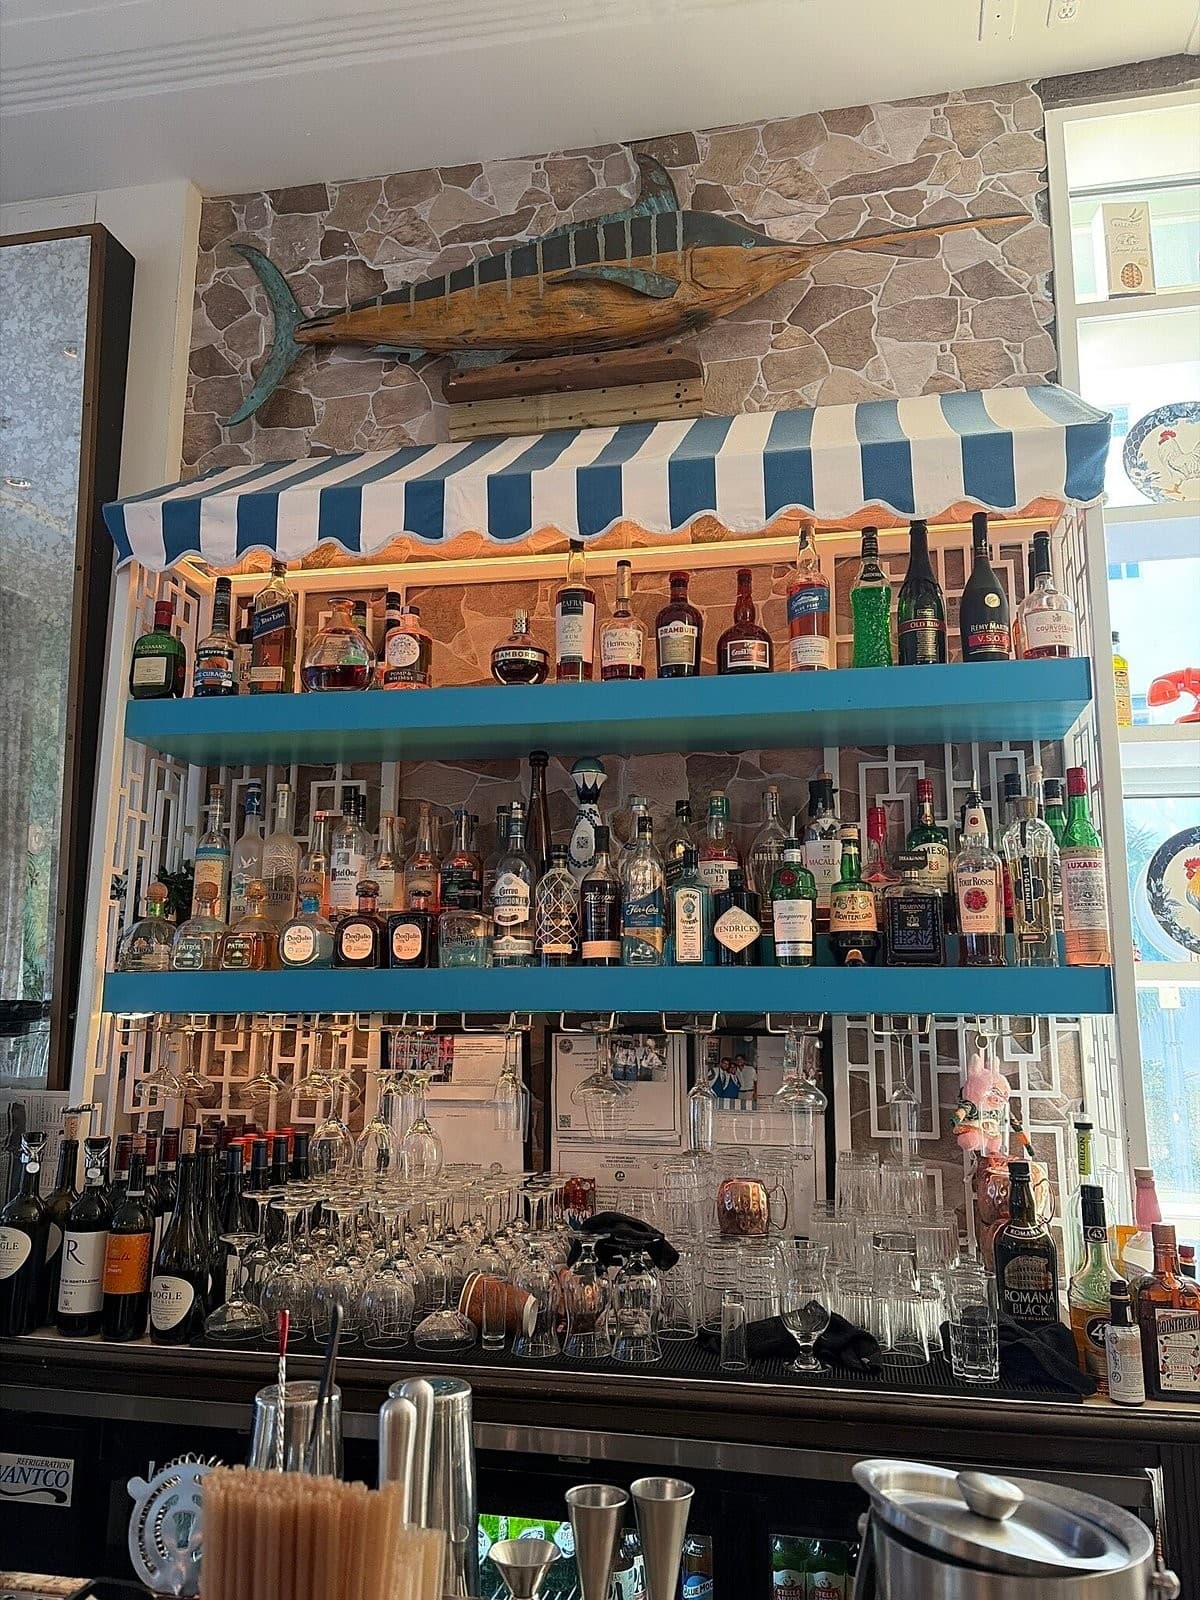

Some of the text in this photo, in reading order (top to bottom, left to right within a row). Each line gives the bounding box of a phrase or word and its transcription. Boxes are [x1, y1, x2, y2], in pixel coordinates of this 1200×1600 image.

[659, 625, 696, 636] DRAMBUIE
[606, 640, 636, 648] Hennessy
[1067, 861, 1103, 869] LUXARDO
[703, 868, 728, 876] GLENLIV
[972, 876, 994, 886] Roses
[777, 912, 808, 921] Tanqueray
[1090, 1230, 1103, 1239] 43
[0, 1242, 19, 1250] GLE
[66, 1239, 87, 1266] R
[1004, 1289, 1055, 1304] ROMANA
[1012, 1303, 1049, 1316] BLACK
[1157, 1315, 1199, 1334] COINTREAU
[16, 1457, 72, 1470] REFRIGERATION
[0, 1464, 70, 1489] VANTCO
[776, 1588, 801, 1596] STELLA
